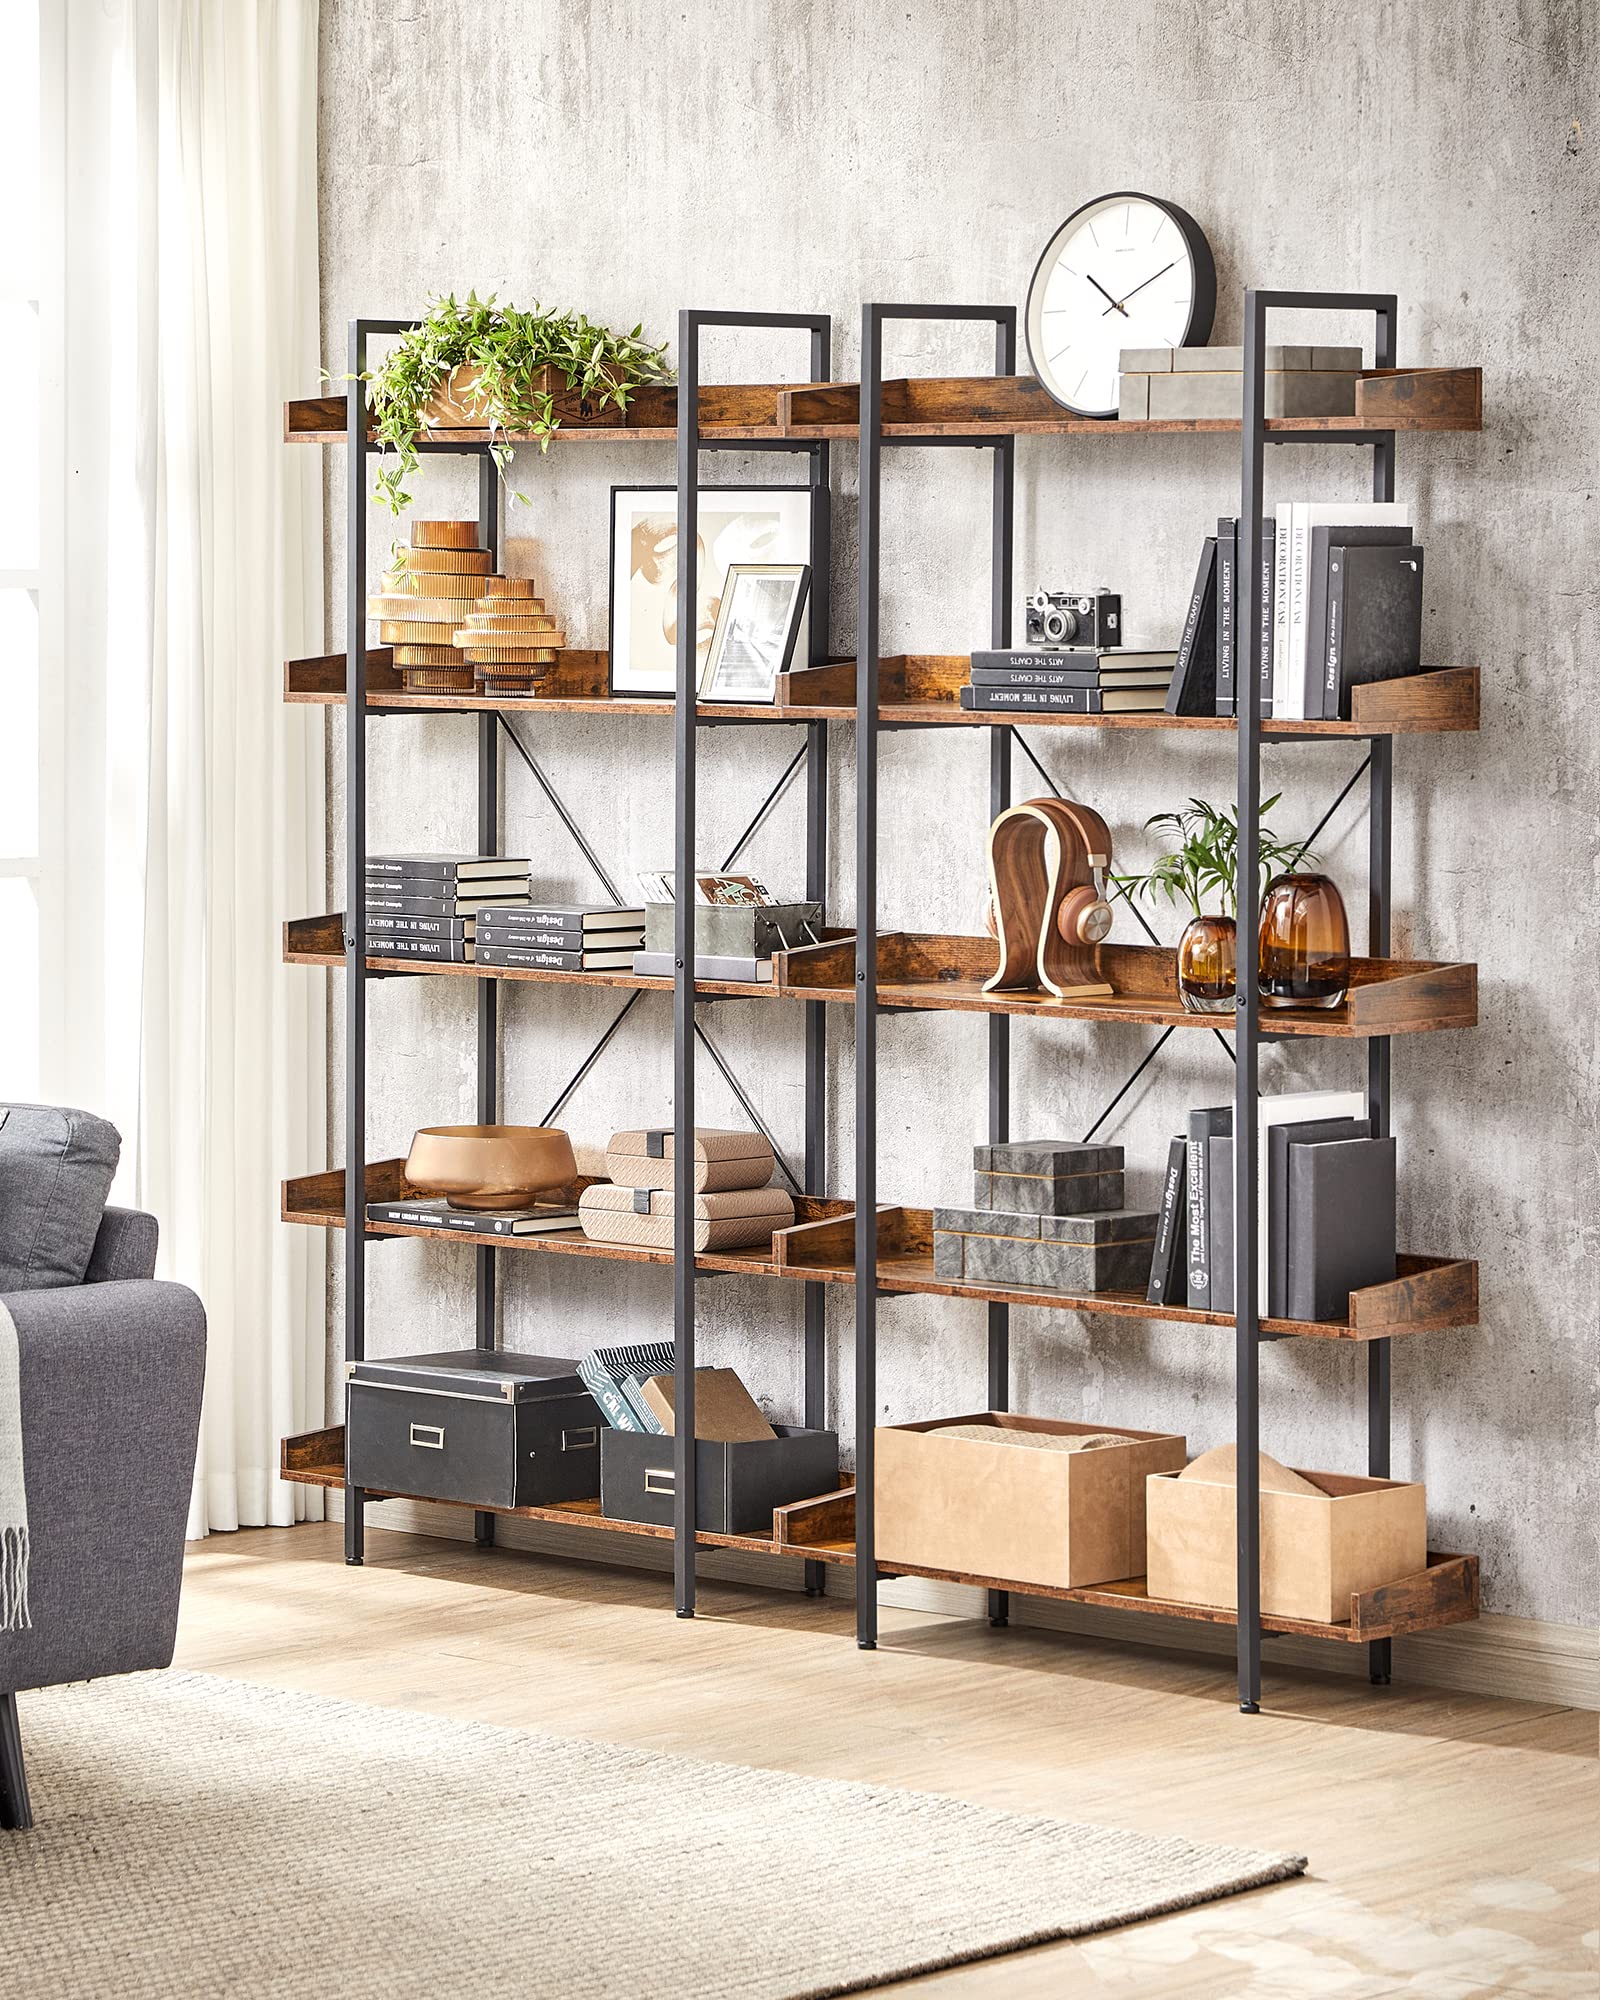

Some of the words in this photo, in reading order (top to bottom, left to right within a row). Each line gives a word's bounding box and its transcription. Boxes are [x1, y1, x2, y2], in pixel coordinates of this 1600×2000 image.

[1223, 560, 1231, 603] MOMENT
[1262, 560, 1270, 604] MOMENT
[1222, 606, 1230, 627] THE
[1262, 607, 1270, 628] THE
[1179, 646, 1188, 668] ARTS
[1184, 627, 1193, 643] THE
[1189, 594, 1201, 625] CRAFTS
[1222, 631, 1230, 641] IN
[1262, 632, 1269, 642] IN
[1010, 657, 1032, 665] CRAFTS
[1049, 658, 1064, 666] ARTS
[1222, 645, 1230, 679] LIVING
[1261, 646, 1269, 680] LIVING
[1327, 647, 1338, 691] Design
[1010, 674, 1033, 682] CRAFTS
[1049, 675, 1064, 683] ARTS
[990, 693, 1020, 702] MOMENT
[1022, 694, 1037, 702] THE
[1040, 694, 1047, 703] IN
[1050, 694, 1074, 704] LIVING
[368, 919, 394, 928] MOMENT
[396, 921, 409, 929] THE
[536, 915, 564, 926] Design
[410, 922, 417, 930] IN
[419, 922, 440, 931] LIVING
[537, 934, 564, 946] Design
[368, 941, 394, 950] MOMENT
[397, 943, 409, 951] THE
[411, 943, 417, 951] IN
[420, 944, 440, 953] LIVING
[536, 954, 563, 966] Design
[1190, 1141, 1199, 1200] Excellent
[1165, 1167, 1178, 1208] Design
[1190, 1203, 1200, 1236] Most
[1191, 1239, 1200, 1264] The
